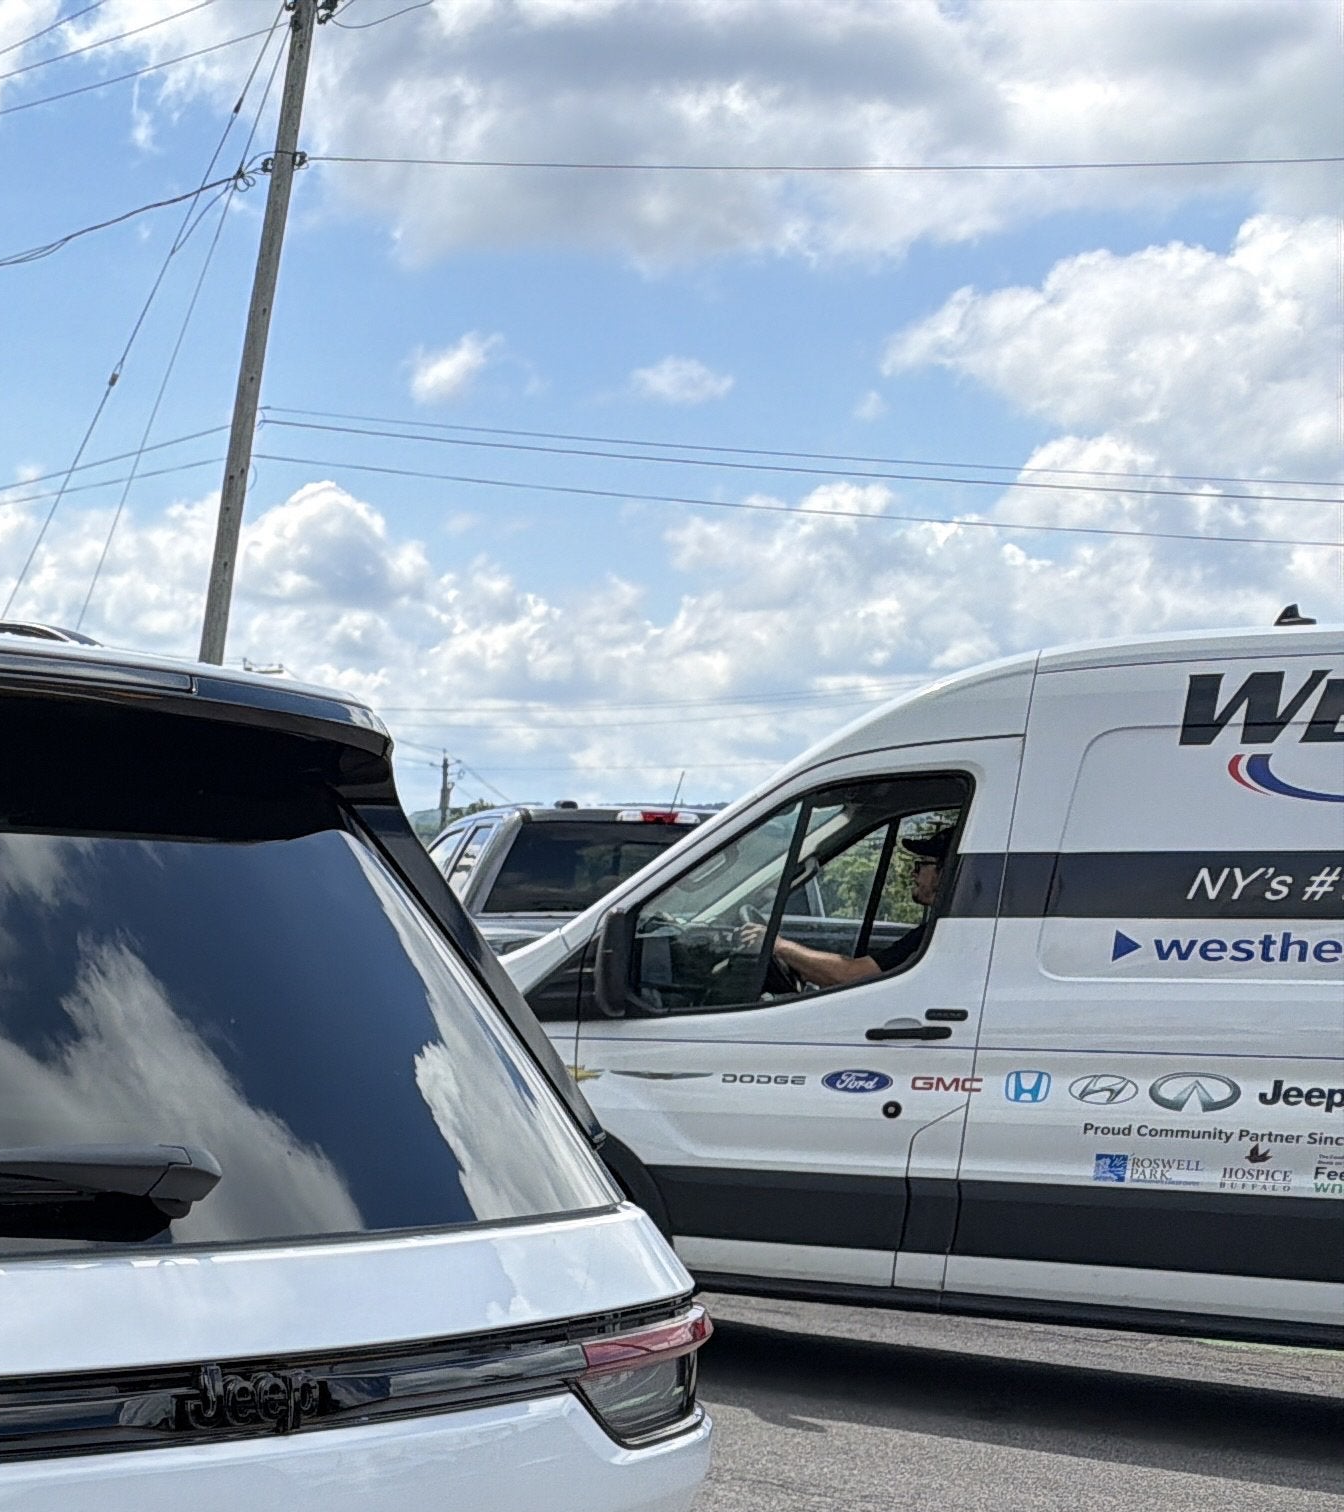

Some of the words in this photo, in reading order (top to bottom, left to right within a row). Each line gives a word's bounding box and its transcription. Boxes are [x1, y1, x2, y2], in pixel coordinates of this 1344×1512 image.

[1186, 866, 1293, 900] NY's
[1153, 931, 1343, 963] westhe
[721, 1072, 807, 1086] DODGE
[835, 1070, 879, 1091] Ford
[911, 1075, 983, 1093] GMC
[1258, 1079, 1344, 1113] Jeep
[1083, 1122, 1132, 1137] Proud
[1137, 1123, 1234, 1143] Community
[1238, 1128, 1303, 1144] Partner
[1306, 1131, 1344, 1146] Sinc
[1131, 1156, 1203, 1172] ROSWELL
[1130, 1168, 1173, 1181] PARK
[1221, 1167, 1293, 1182] HOSPICE
[1219, 1182, 1291, 1192] BUFFALO
[184, 1364, 321, 1433] Jeep
